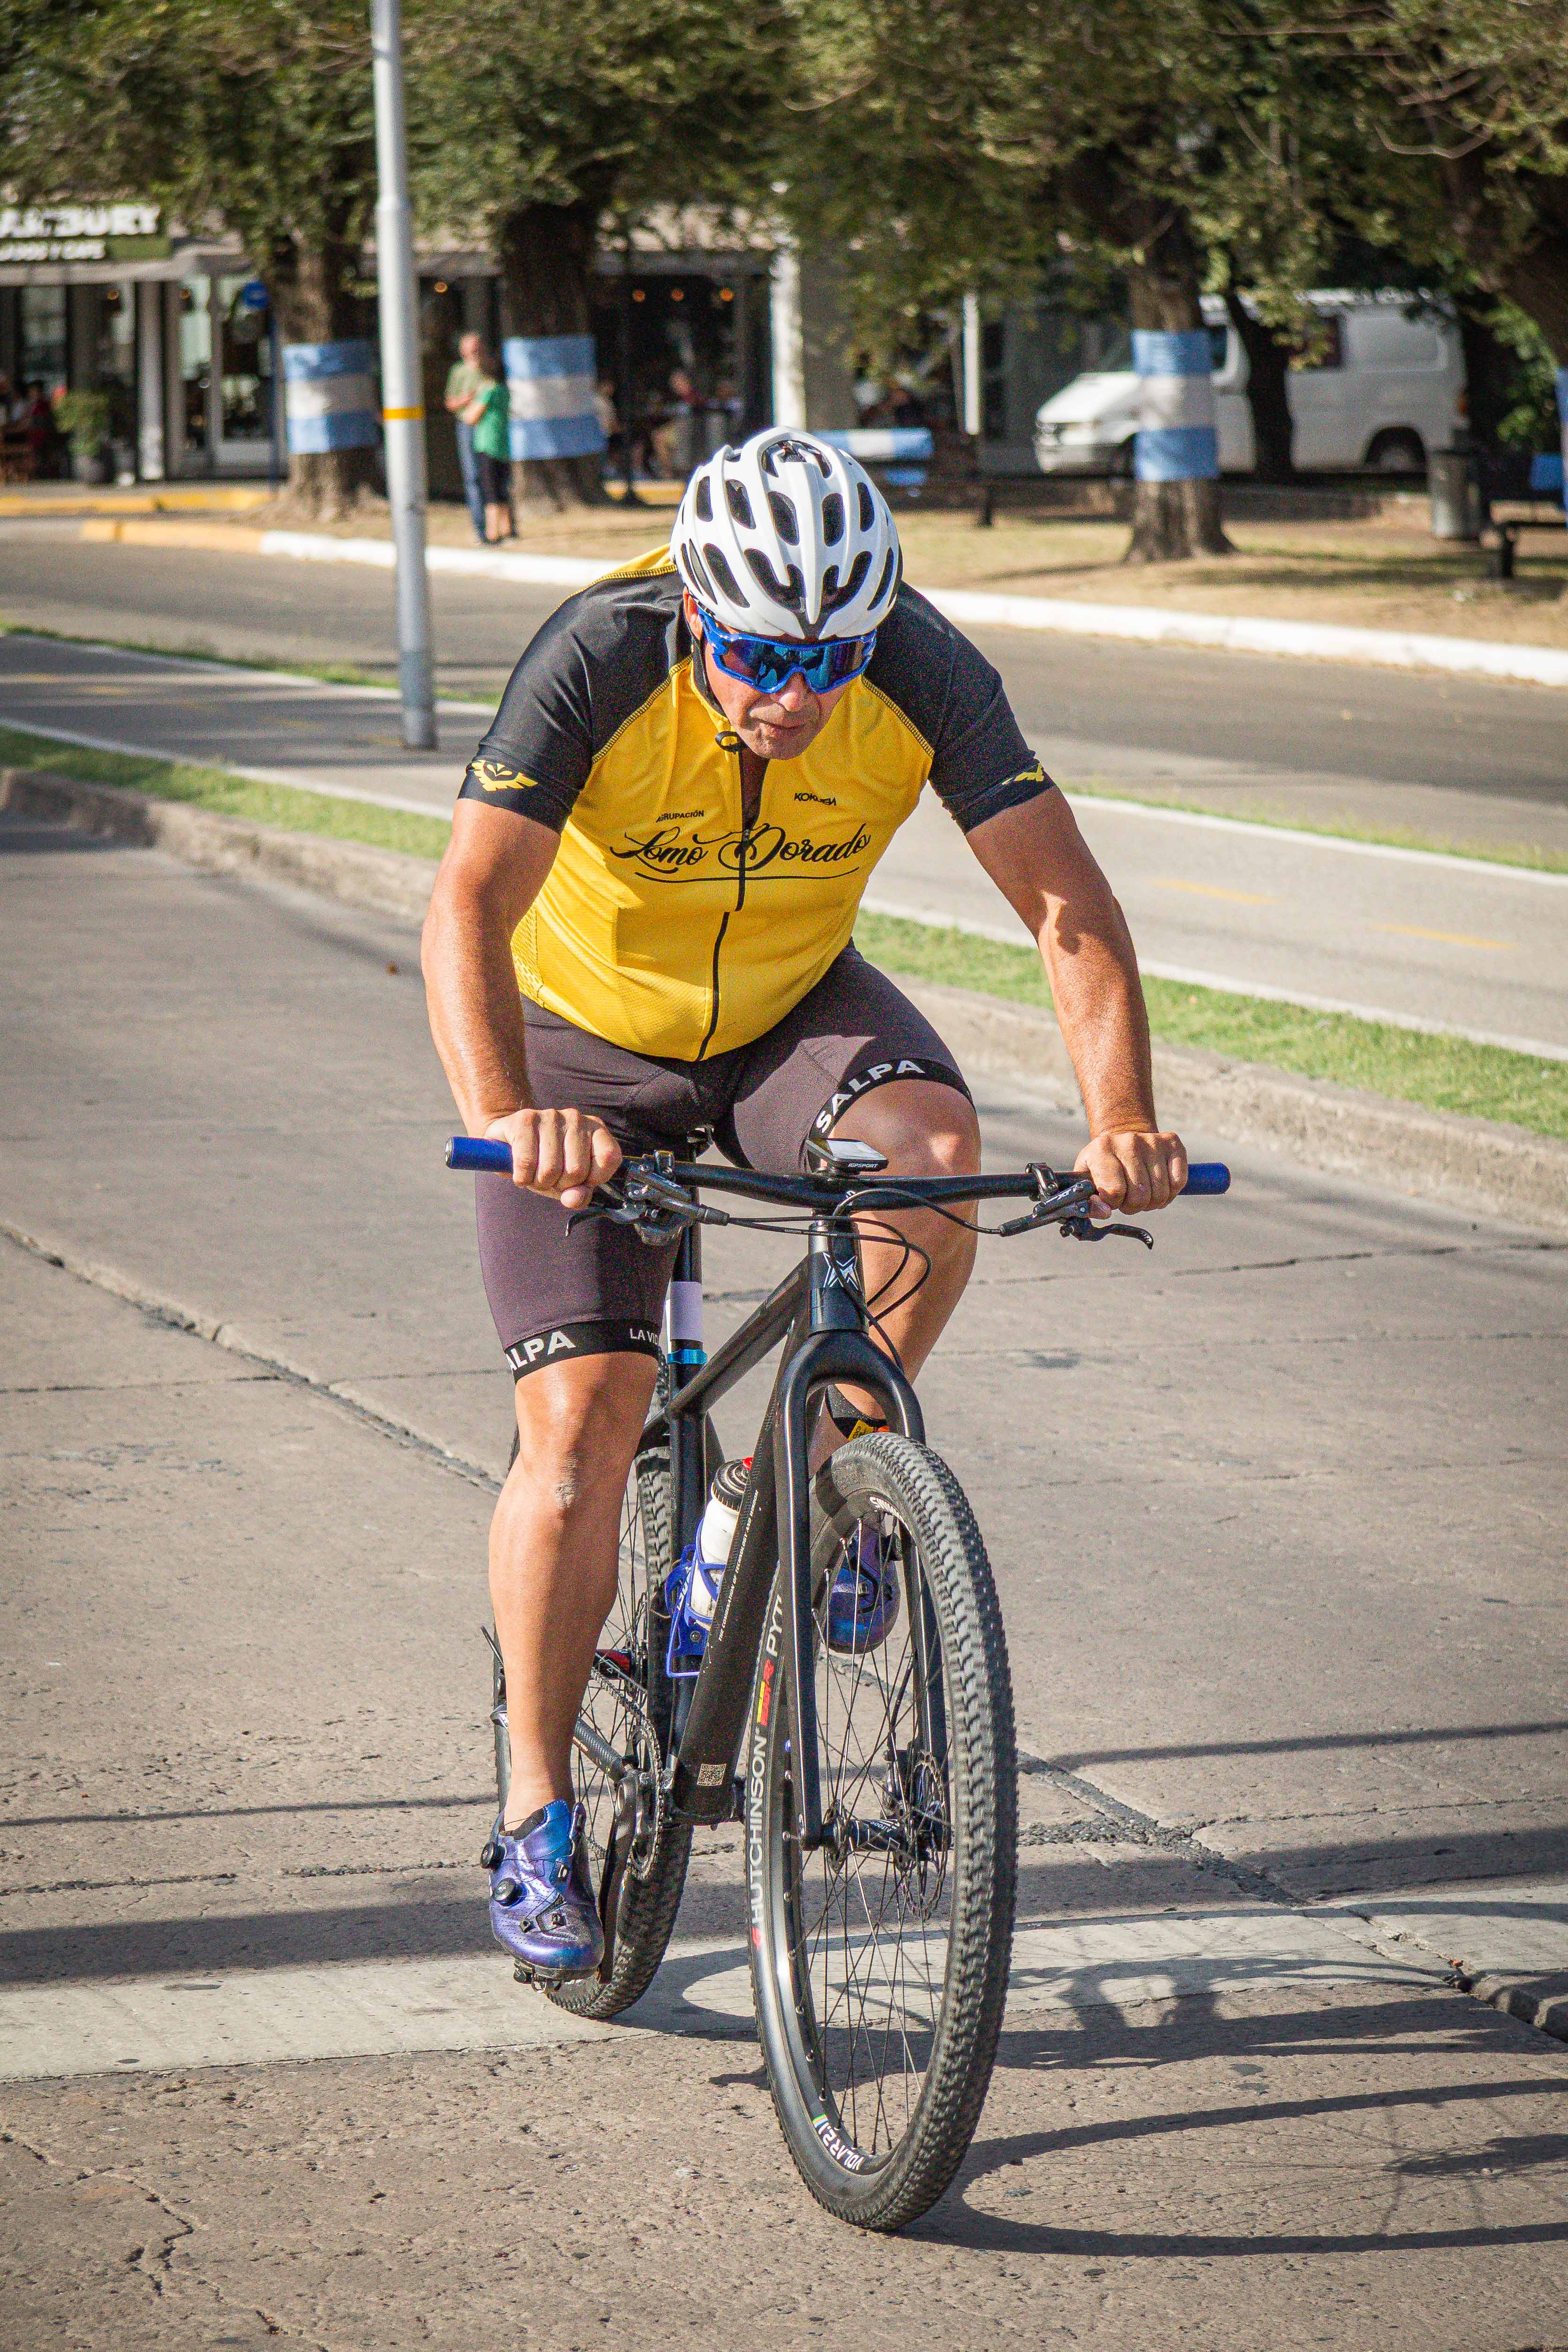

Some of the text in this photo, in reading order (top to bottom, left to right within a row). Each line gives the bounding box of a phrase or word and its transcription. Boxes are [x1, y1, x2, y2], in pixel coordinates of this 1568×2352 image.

[656, 810, 705, 823] AGRUPACIÓN
[610, 823, 871, 874] Lomo Dorado
[816, 1060, 925, 1134] SALPA
[505, 1331, 577, 1371] ALPA
[630, 1328, 645, 1341] LA
[750, 1734, 767, 1924] HUTCHINSON
[829, 2138, 865, 2171] VOLAR
